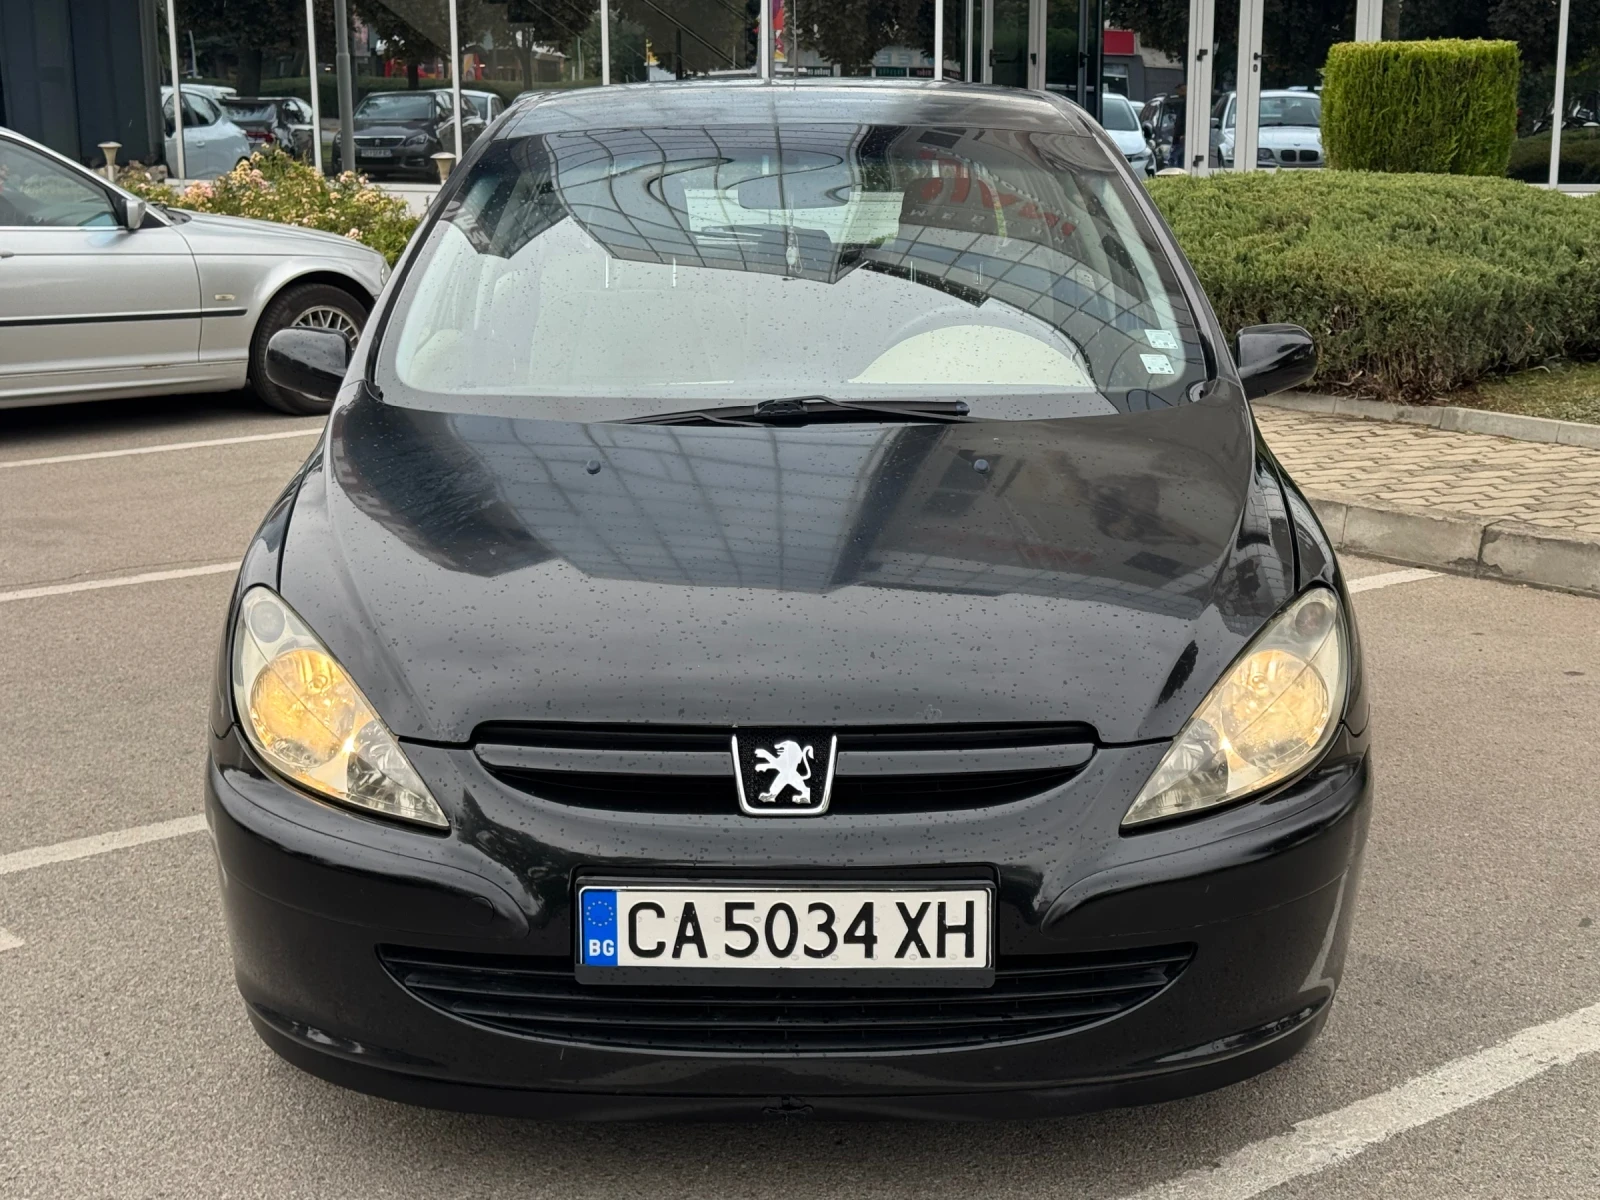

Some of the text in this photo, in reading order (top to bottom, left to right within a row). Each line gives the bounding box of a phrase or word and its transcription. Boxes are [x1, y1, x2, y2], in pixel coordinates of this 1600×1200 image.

[588, 939, 615, 957] BG
[628, 901, 975, 959] CA 5034 XH
